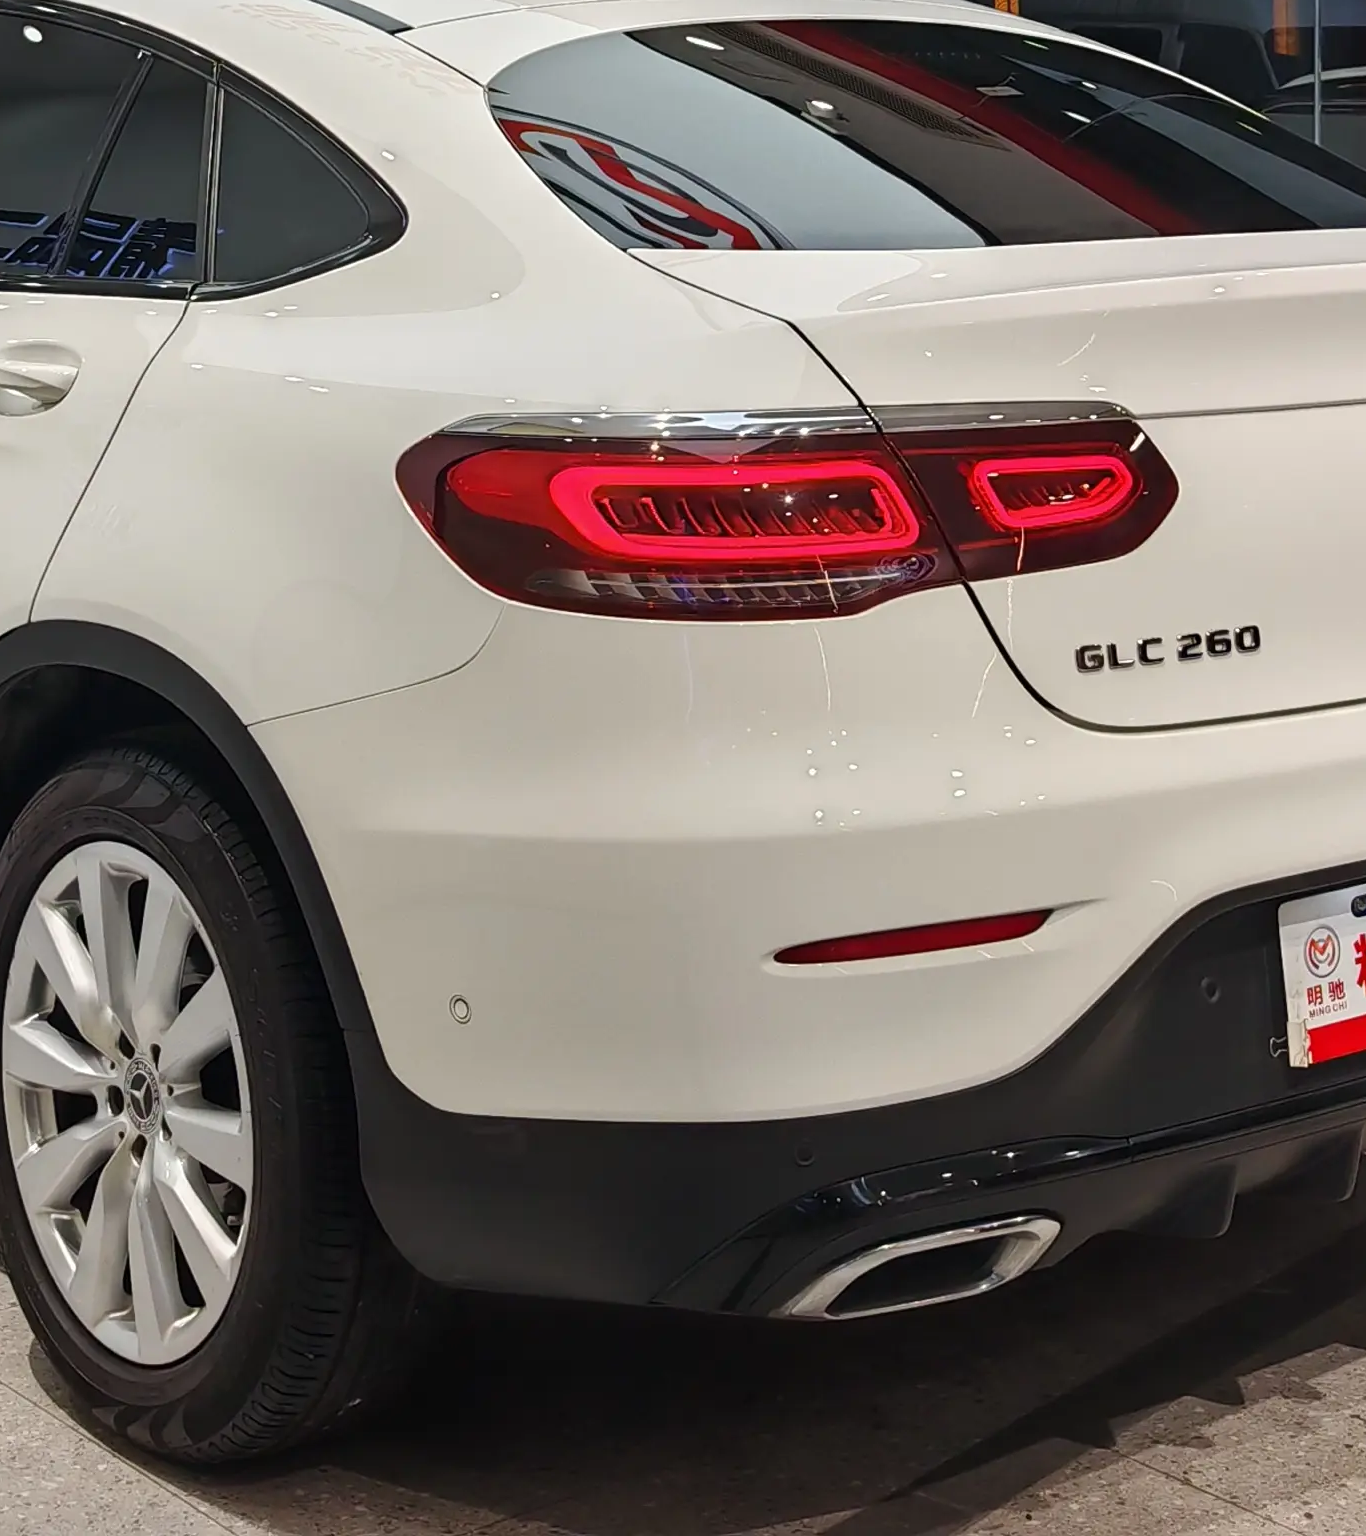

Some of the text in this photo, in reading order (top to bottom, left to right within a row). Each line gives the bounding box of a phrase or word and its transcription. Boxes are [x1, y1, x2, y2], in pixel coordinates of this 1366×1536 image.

[1075, 624, 1262, 674] GLC 260
[1306, 978, 1347, 1007] 明驰
[1308, 1000, 1348, 1020] MING CHI
